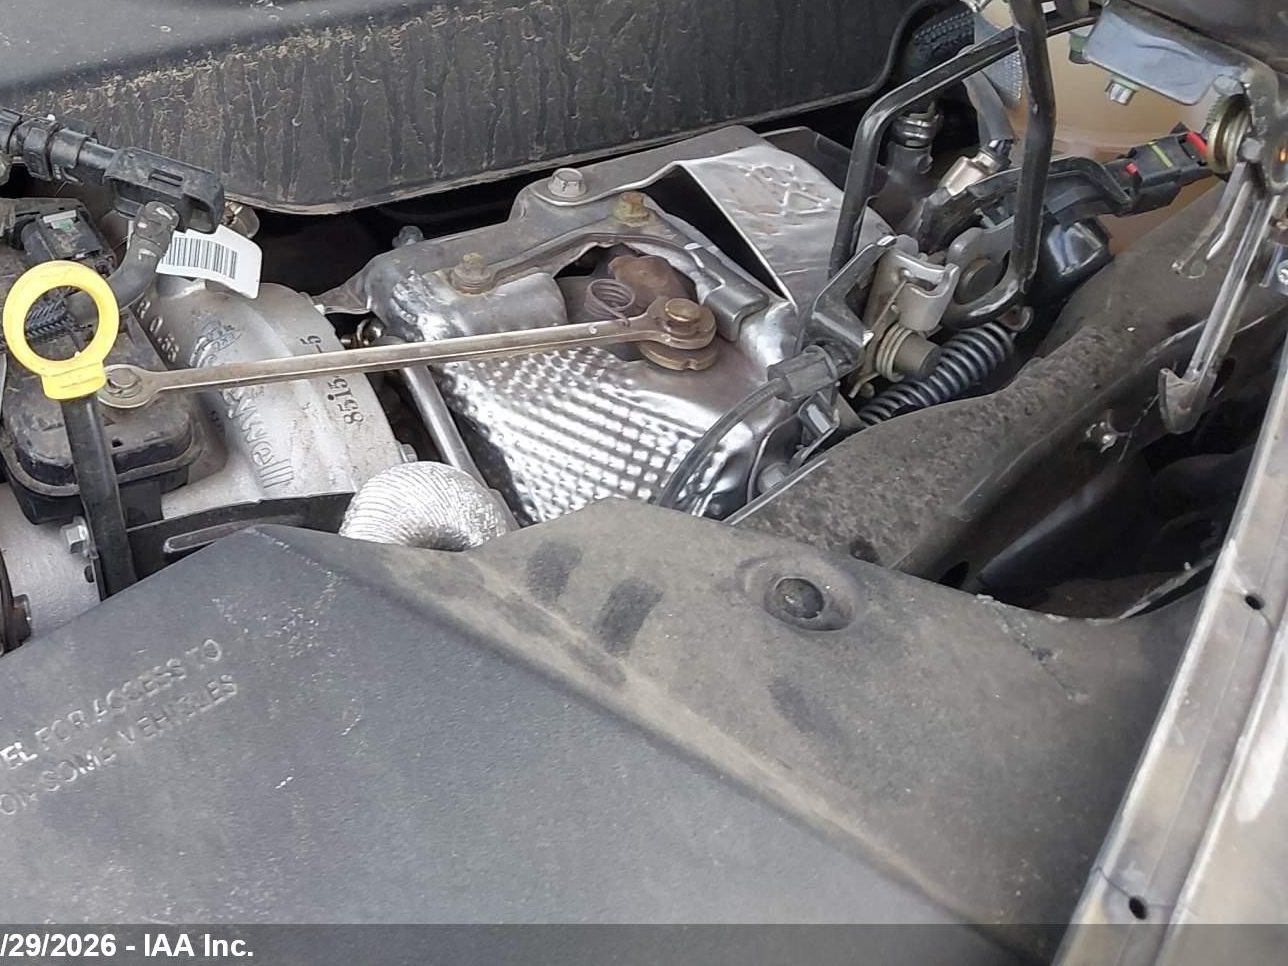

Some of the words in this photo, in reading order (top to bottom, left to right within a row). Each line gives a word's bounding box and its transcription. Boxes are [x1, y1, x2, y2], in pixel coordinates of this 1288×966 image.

[35, 709, 92, 752] FOR
[91, 658, 188, 724] ACCESS
[186, 638, 224, 667] TO
[41, 744, 116, 793] SOME
[118, 674, 239, 748] VEHICLES
